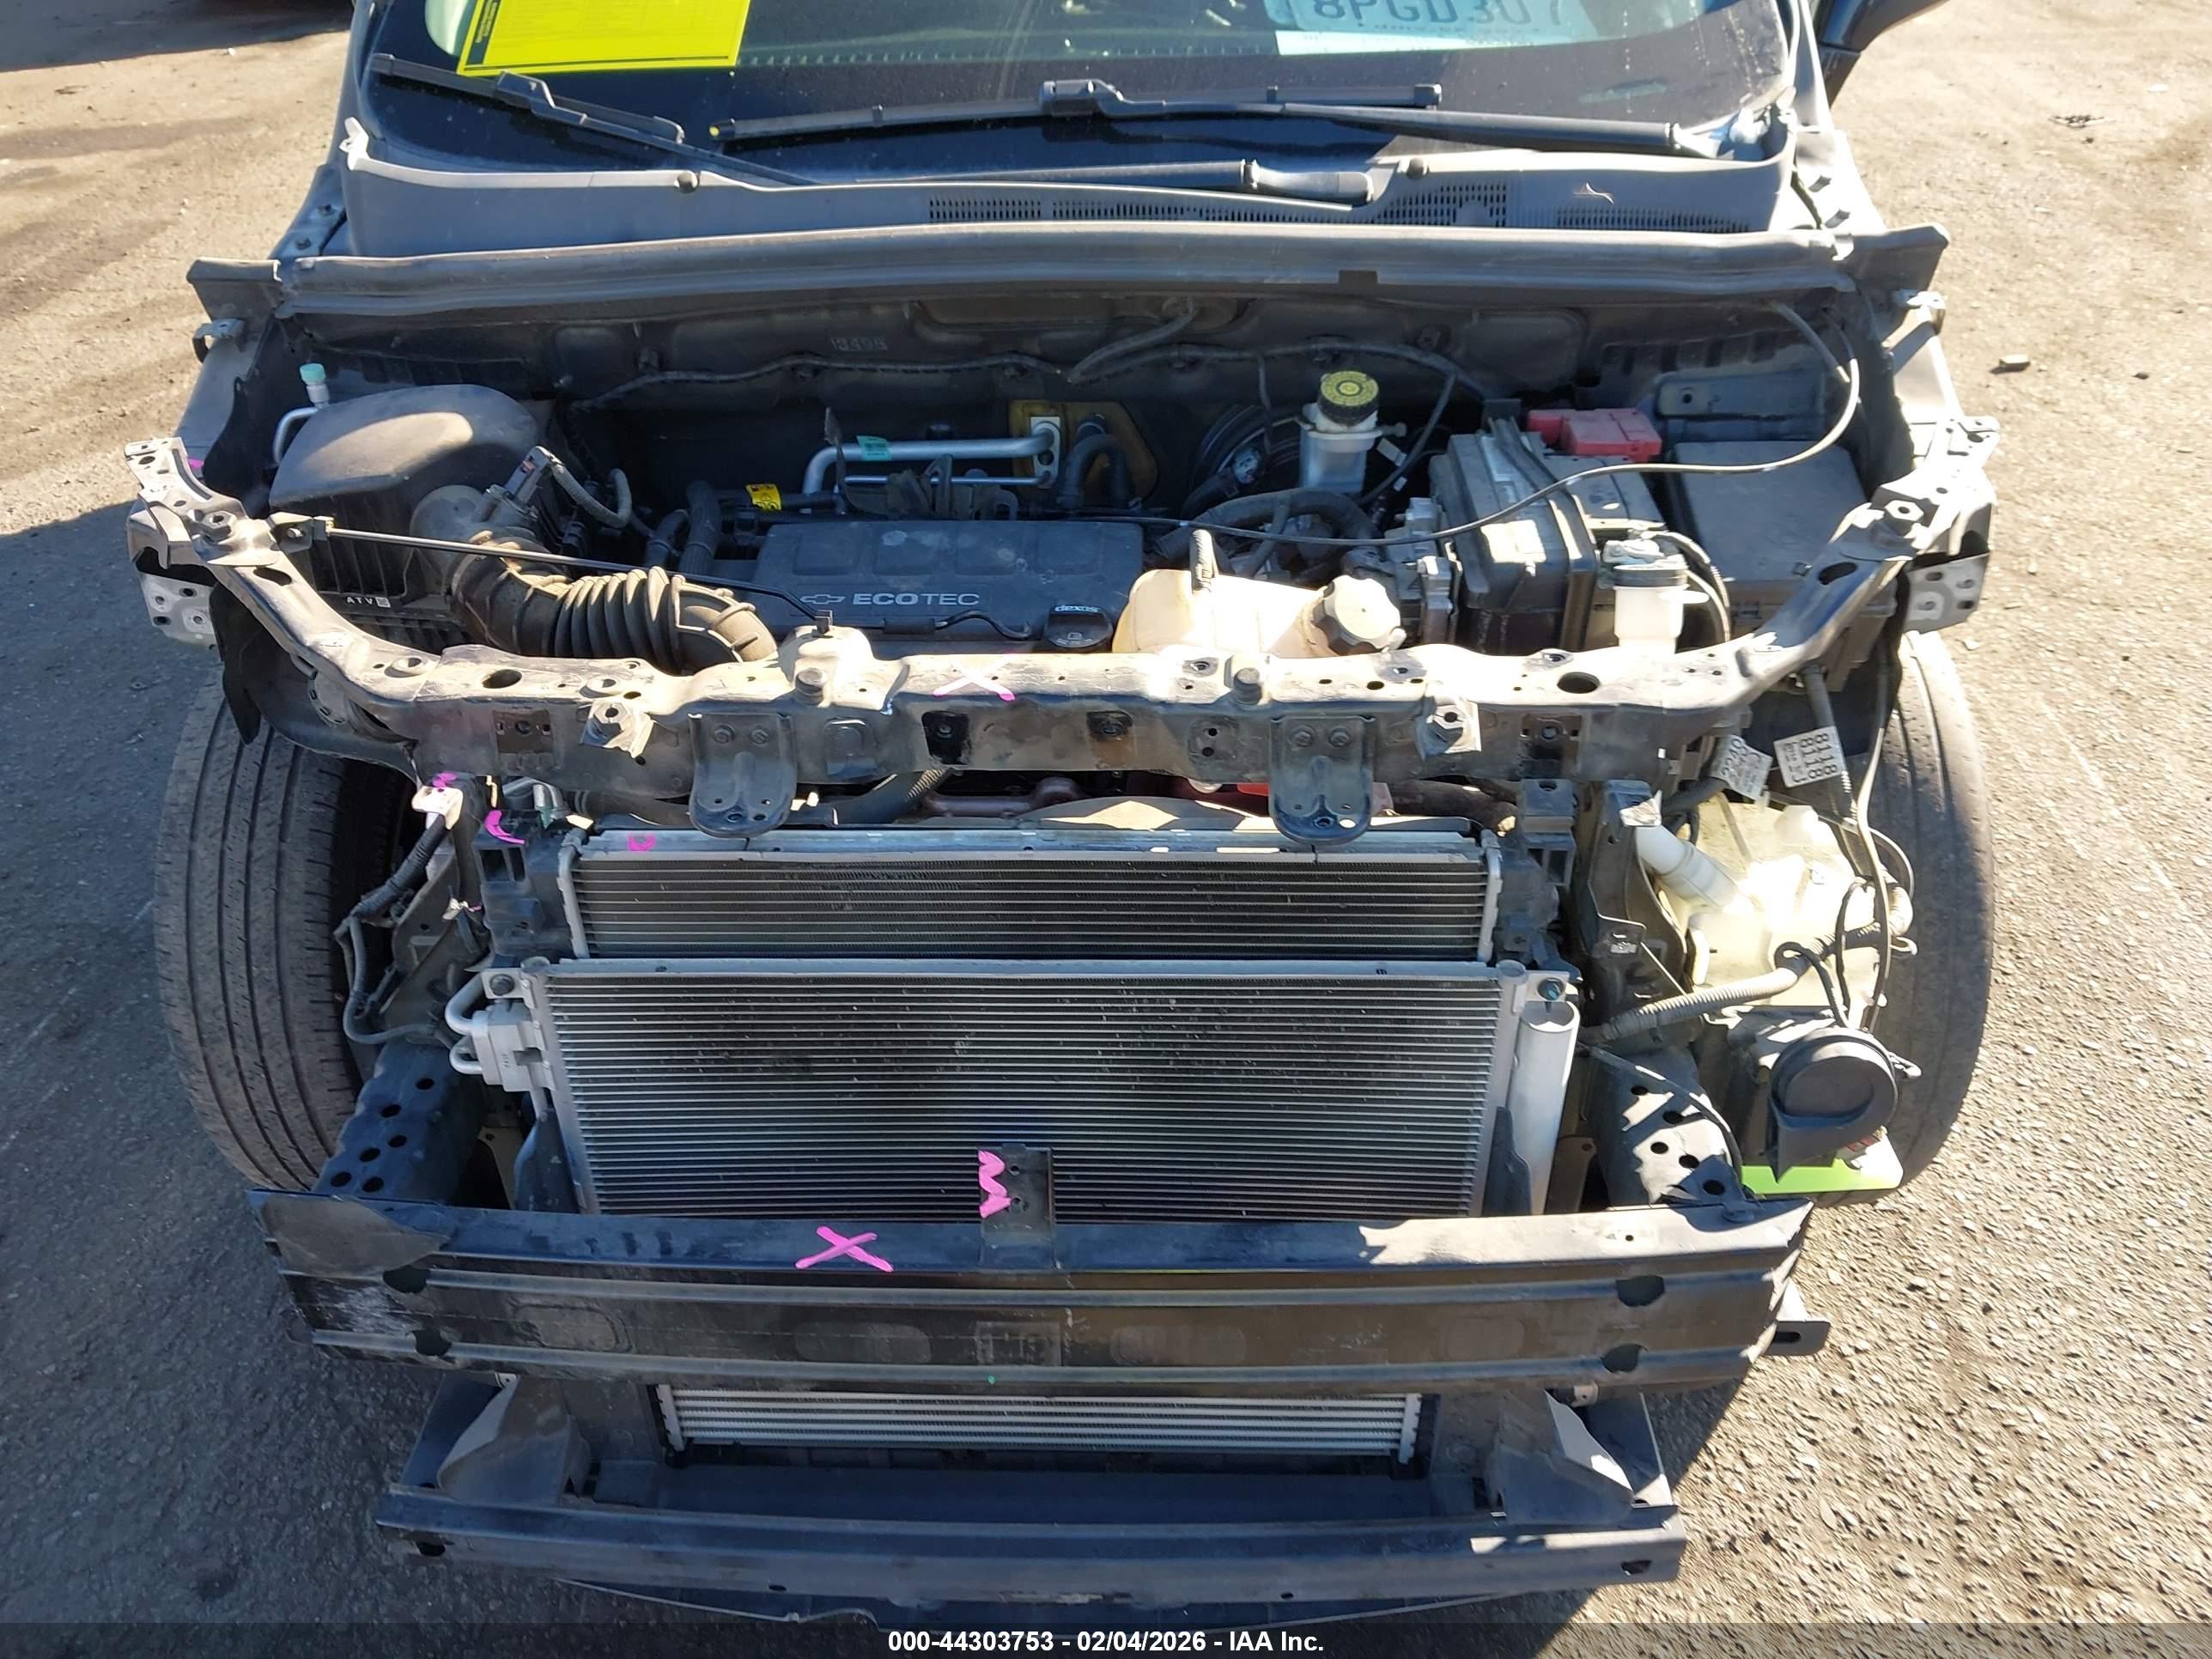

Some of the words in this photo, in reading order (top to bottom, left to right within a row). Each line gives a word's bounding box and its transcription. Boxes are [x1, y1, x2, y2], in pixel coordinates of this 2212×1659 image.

[345, 596, 374, 605] ATV
[852, 592, 981, 606] ECOTEC
[1054, 605, 1101, 613] dexos
